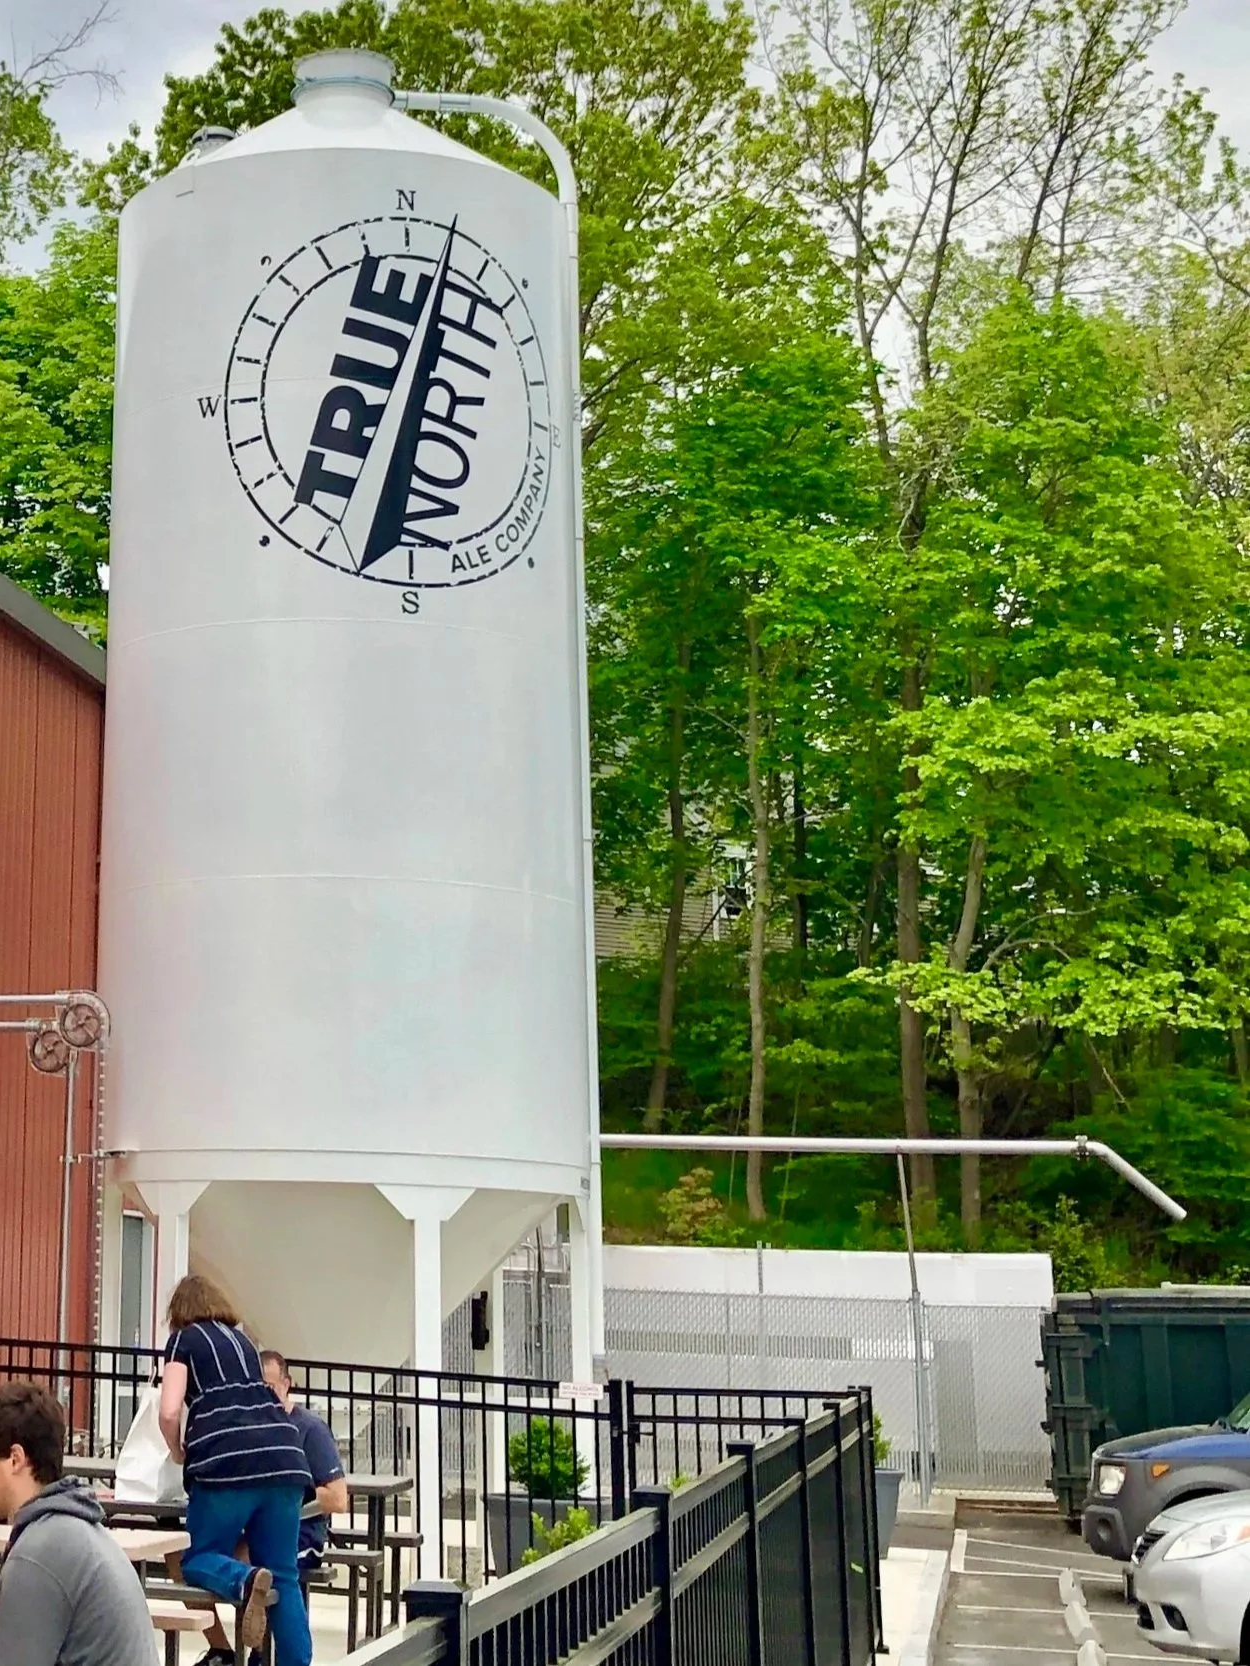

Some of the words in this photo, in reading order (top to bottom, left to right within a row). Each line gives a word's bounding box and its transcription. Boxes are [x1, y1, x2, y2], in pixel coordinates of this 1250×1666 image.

[395, 188, 417, 212] N
[196, 394, 222, 419] W
[293, 253, 434, 505] TRUE
[399, 278, 503, 552] NORTH
[450, 544, 492, 574] ALE
[494, 445, 546, 553] COMPANY
[401, 590, 420, 615] S
